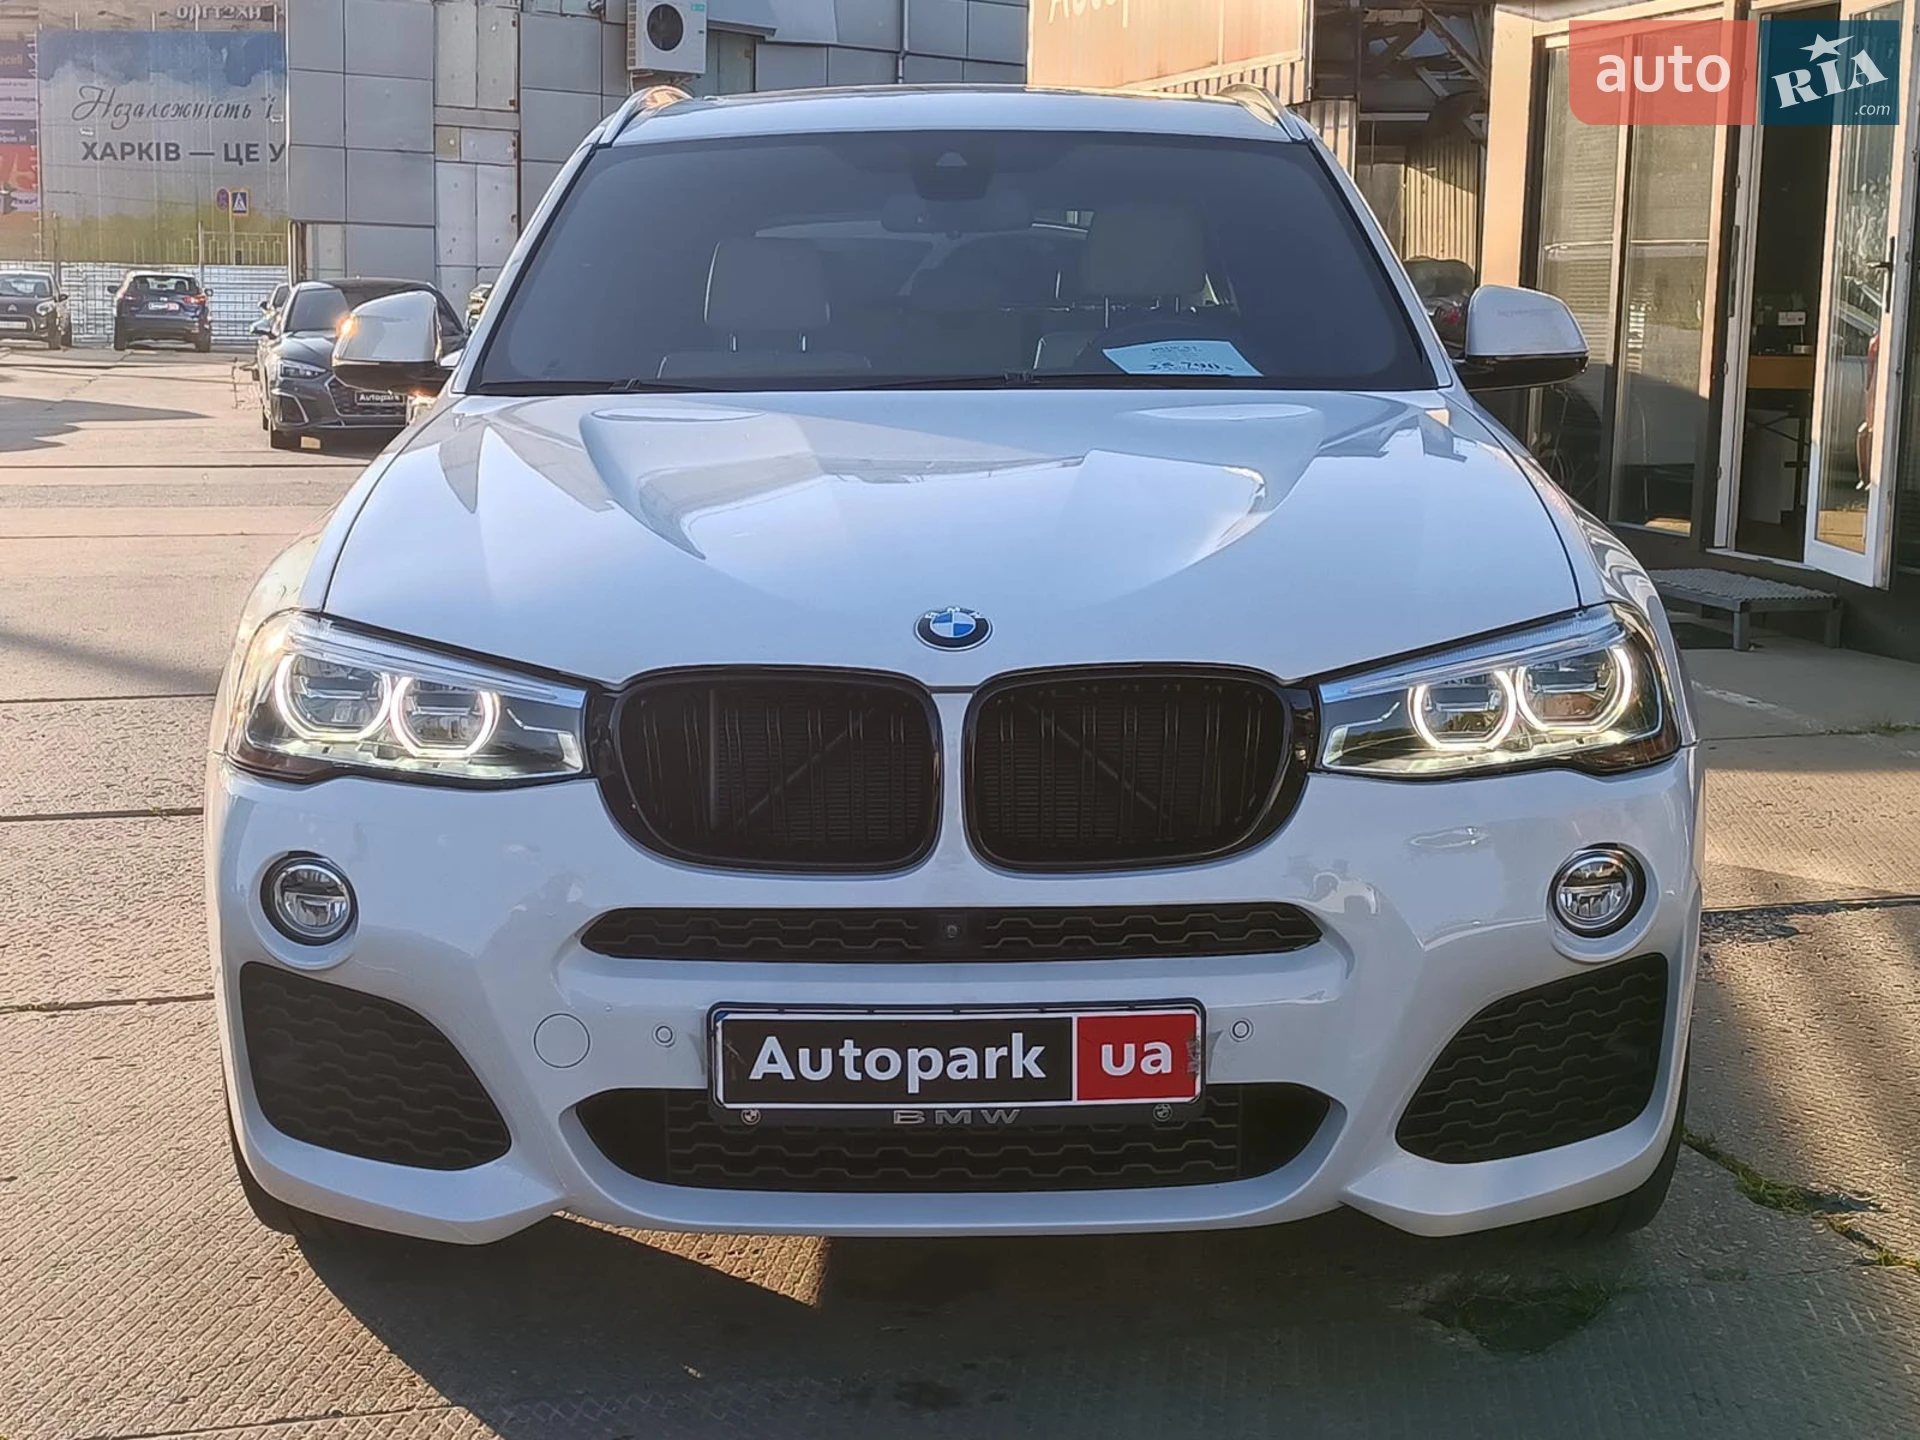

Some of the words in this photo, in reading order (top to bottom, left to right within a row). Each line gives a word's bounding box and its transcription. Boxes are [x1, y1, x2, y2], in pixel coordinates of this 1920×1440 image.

[71, 85, 252, 131] Незалежність
[82, 142, 181, 161] ХАРКІВ
[223, 143, 260, 166] ЦЕ
[748, 1032, 1046, 1094] Autopark
[1099, 1040, 1173, 1075] ua
[892, 1108, 1021, 1124] BMW
